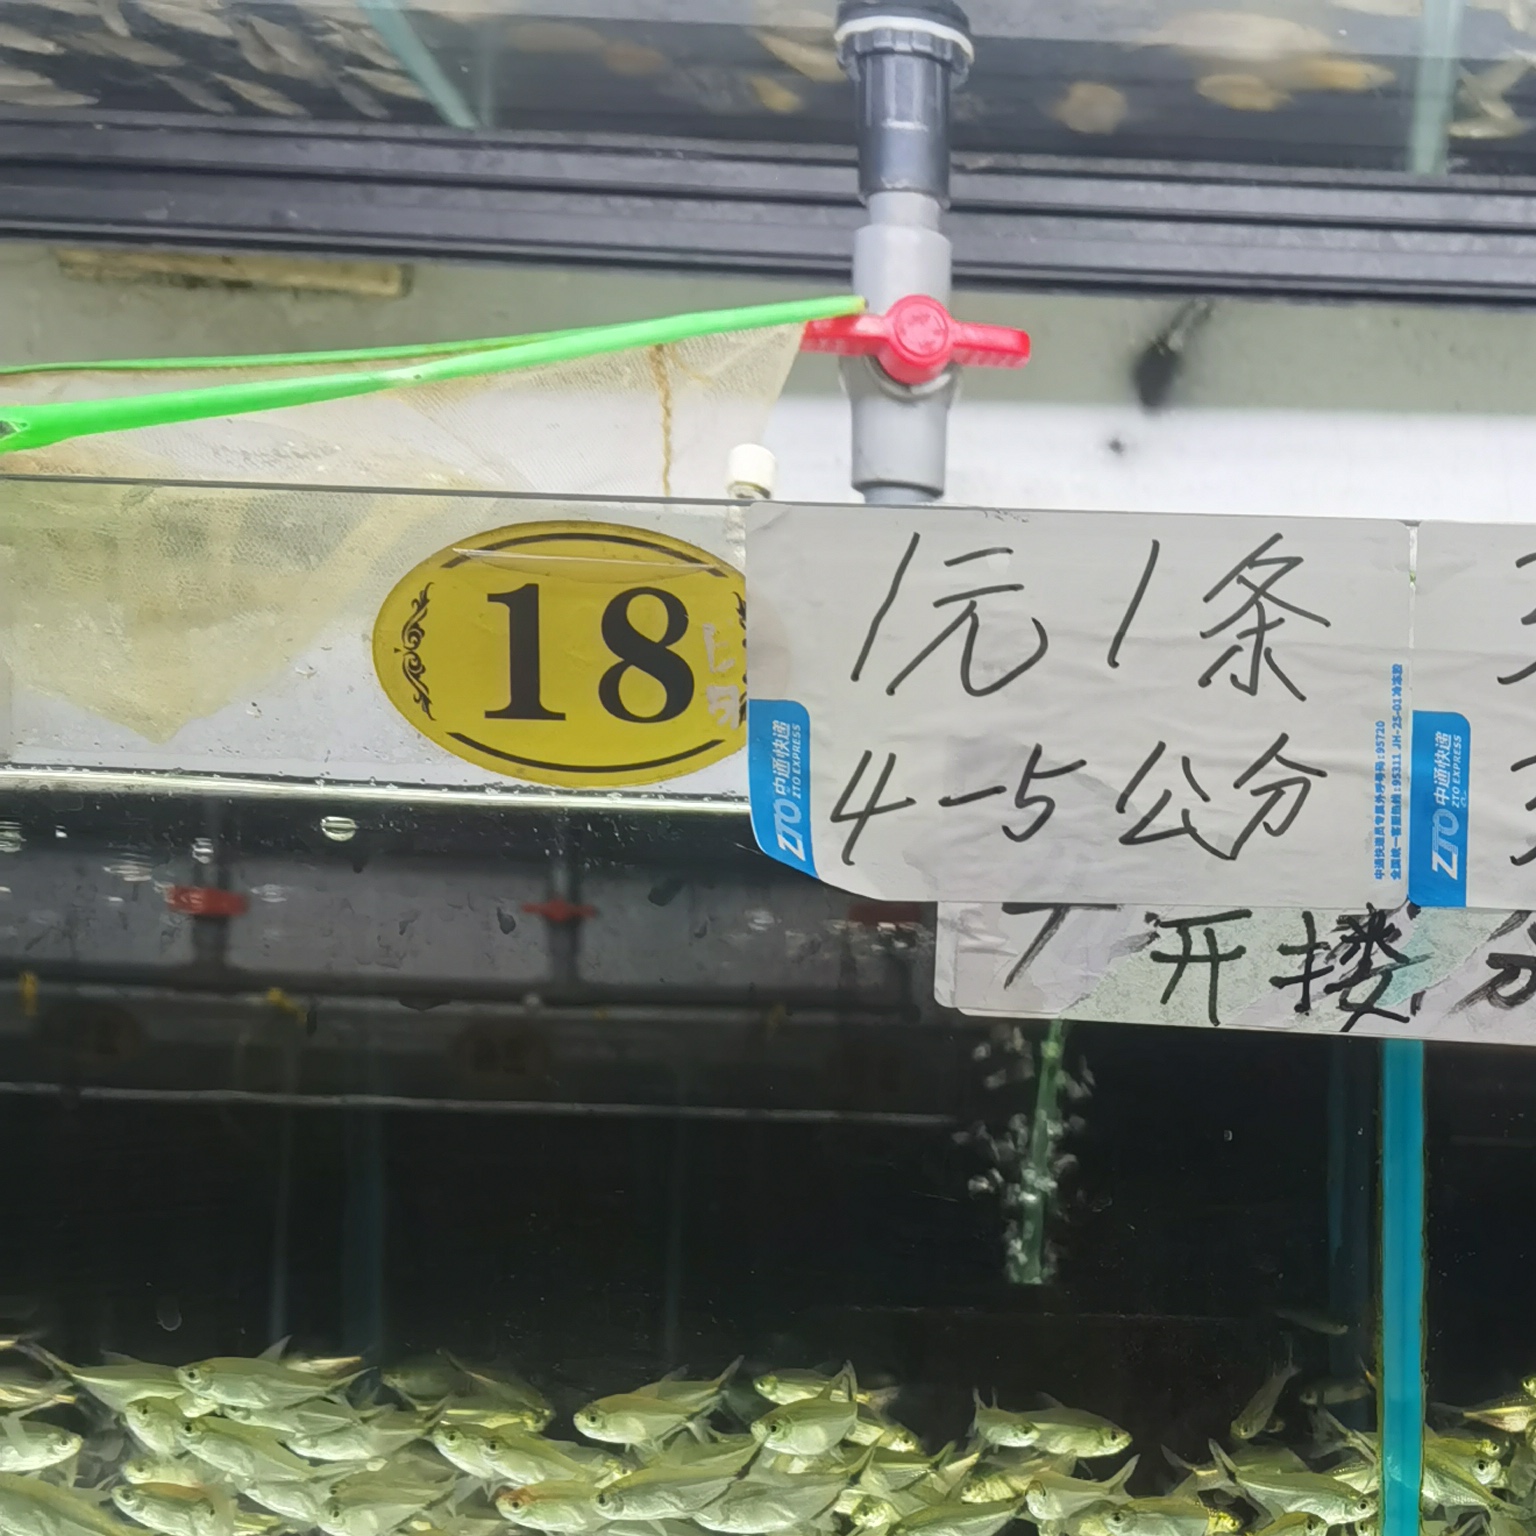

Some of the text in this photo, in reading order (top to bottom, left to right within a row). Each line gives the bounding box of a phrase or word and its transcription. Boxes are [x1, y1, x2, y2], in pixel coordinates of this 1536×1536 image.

[484, 583, 695, 724] 18
[772, 719, 791, 796] 中通快递
[791, 724, 801, 799] ZTO EXPRESS
[1433, 730, 1452, 806] 中通快递
[1451, 735, 1463, 809] ZTO EXPRESS
[773, 798, 806, 862] ZTO
[1432, 808, 1460, 880] ZTO
